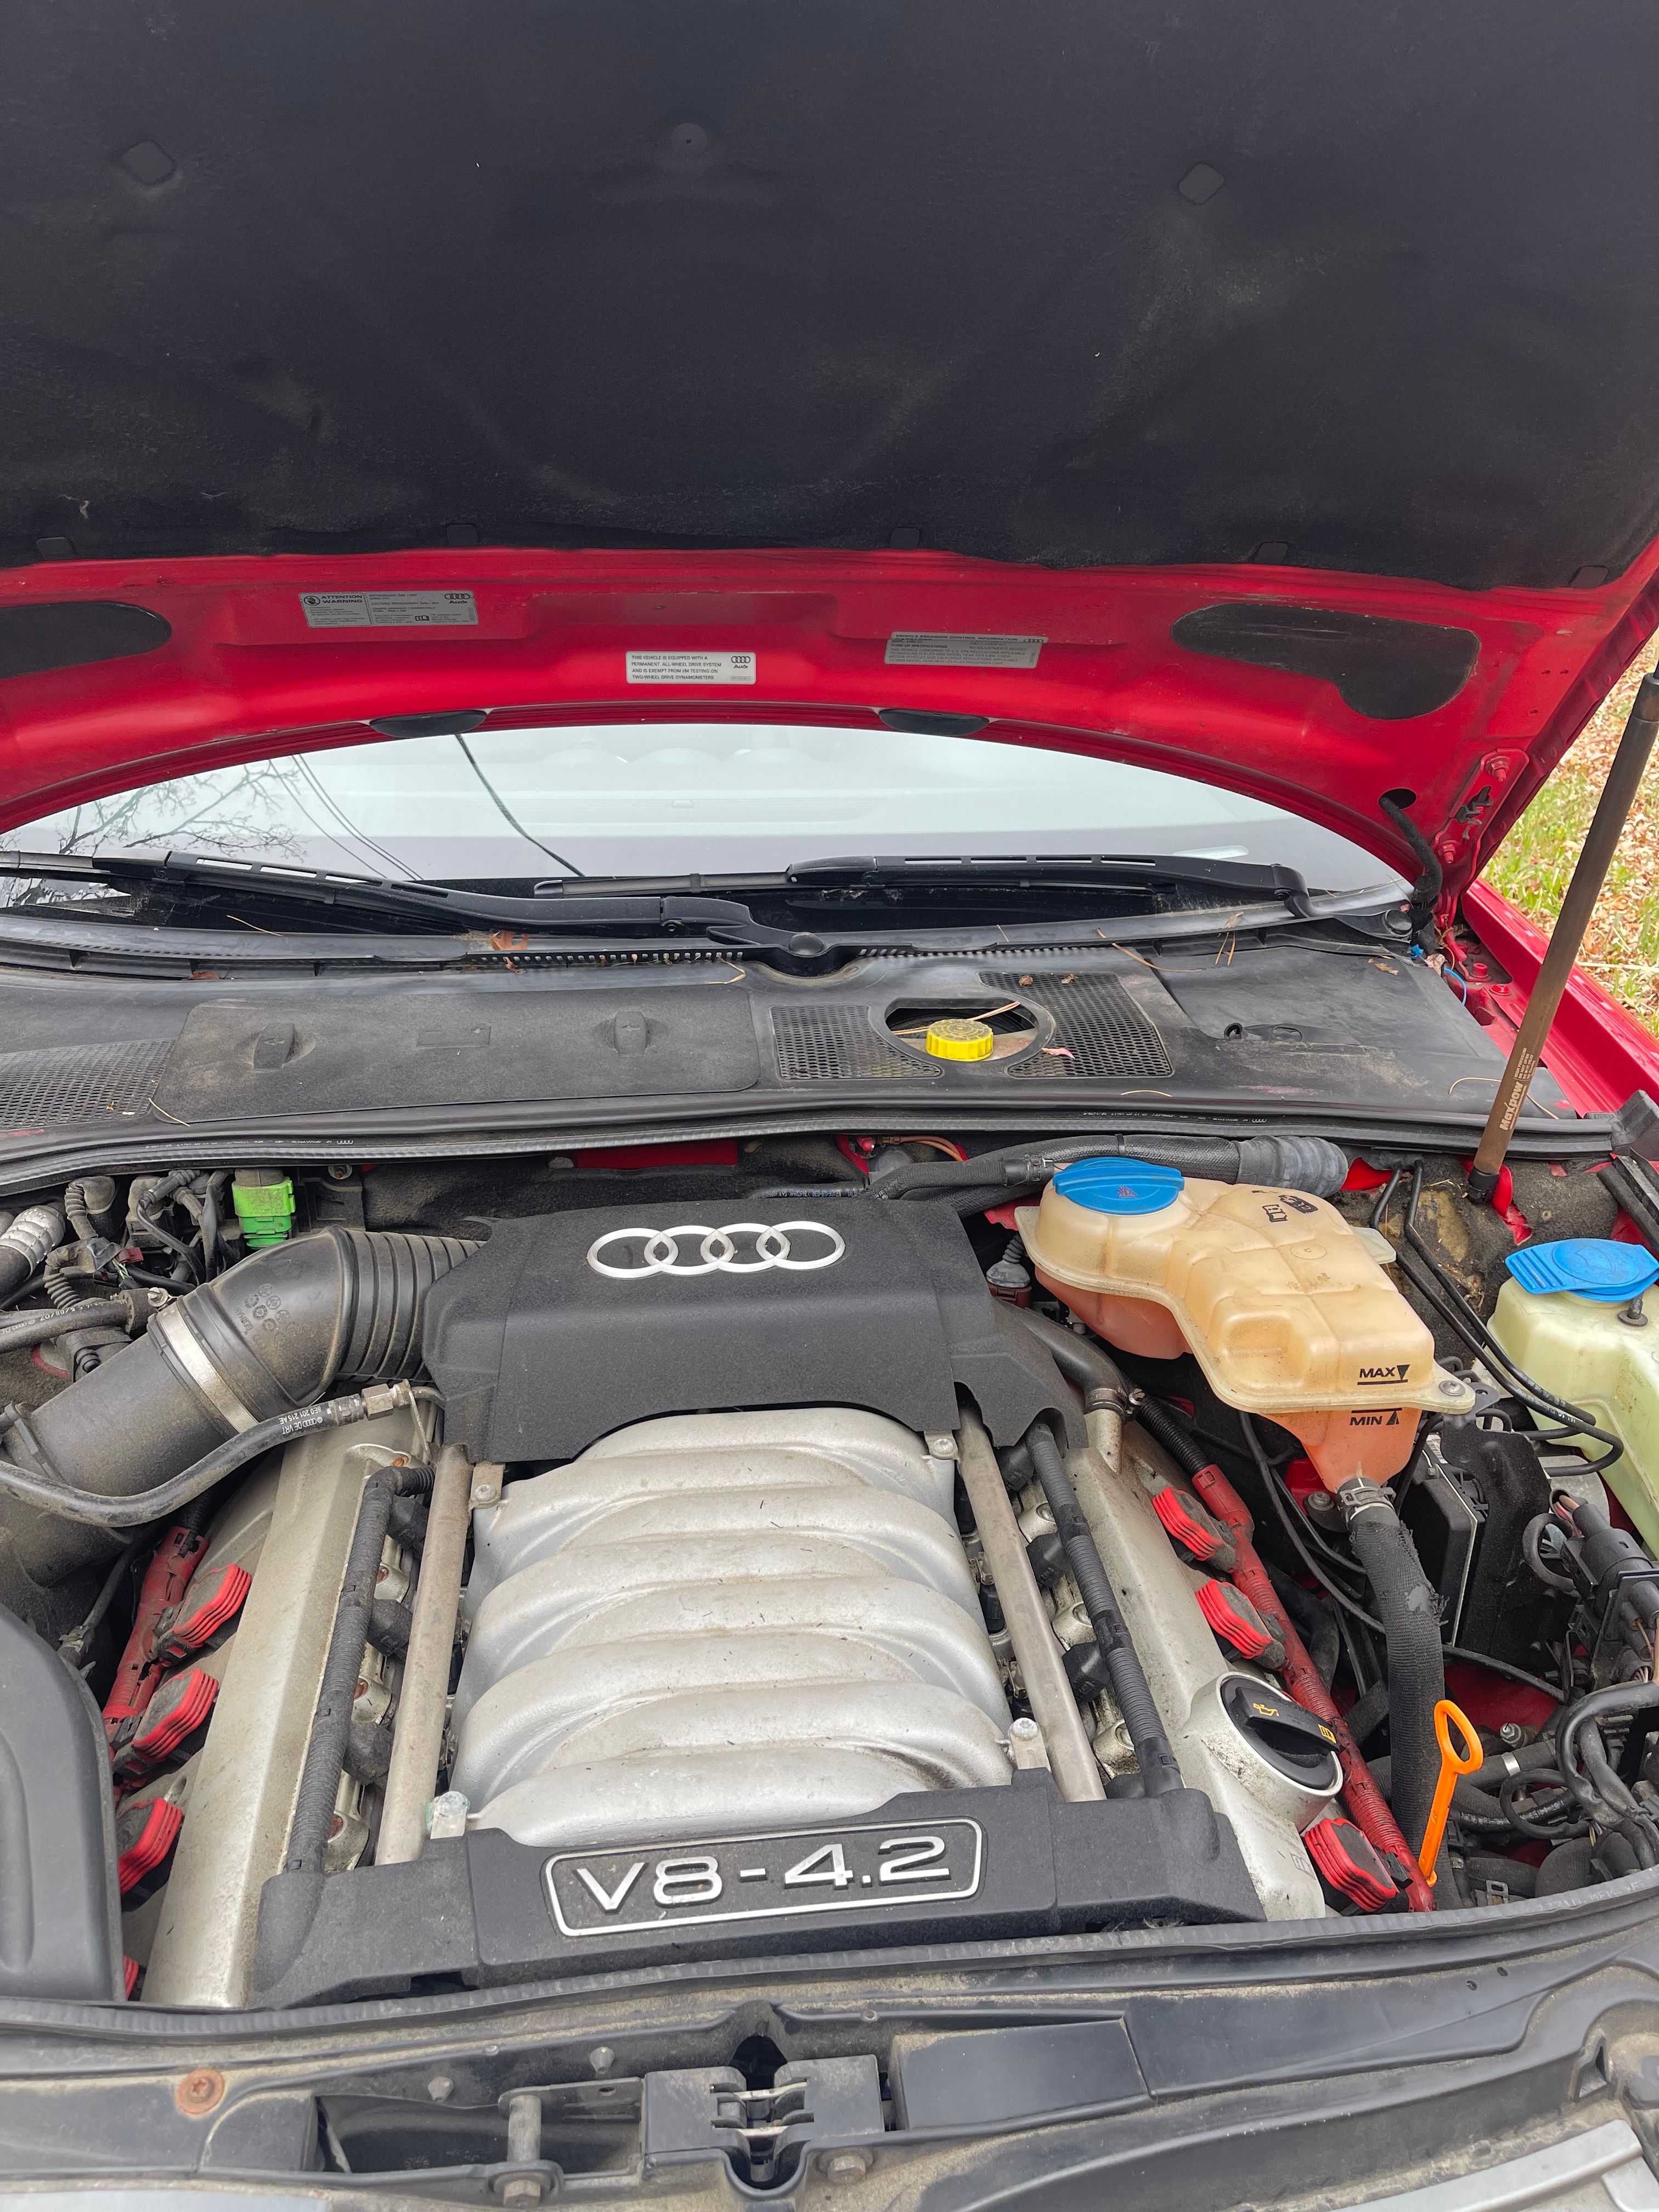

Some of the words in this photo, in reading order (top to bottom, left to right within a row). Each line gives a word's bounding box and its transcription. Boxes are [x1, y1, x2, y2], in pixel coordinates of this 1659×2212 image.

[1499, 1081, 1523, 1131] Maxpow
[1359, 1367, 1396, 1379] MAX
[287, 1412, 299, 1421] 215
[298, 1409, 309, 1418] 201
[278, 1415, 287, 1425] AE
[1350, 1415, 1383, 1426] MIN
[281, 1424, 294, 1435] VRT
